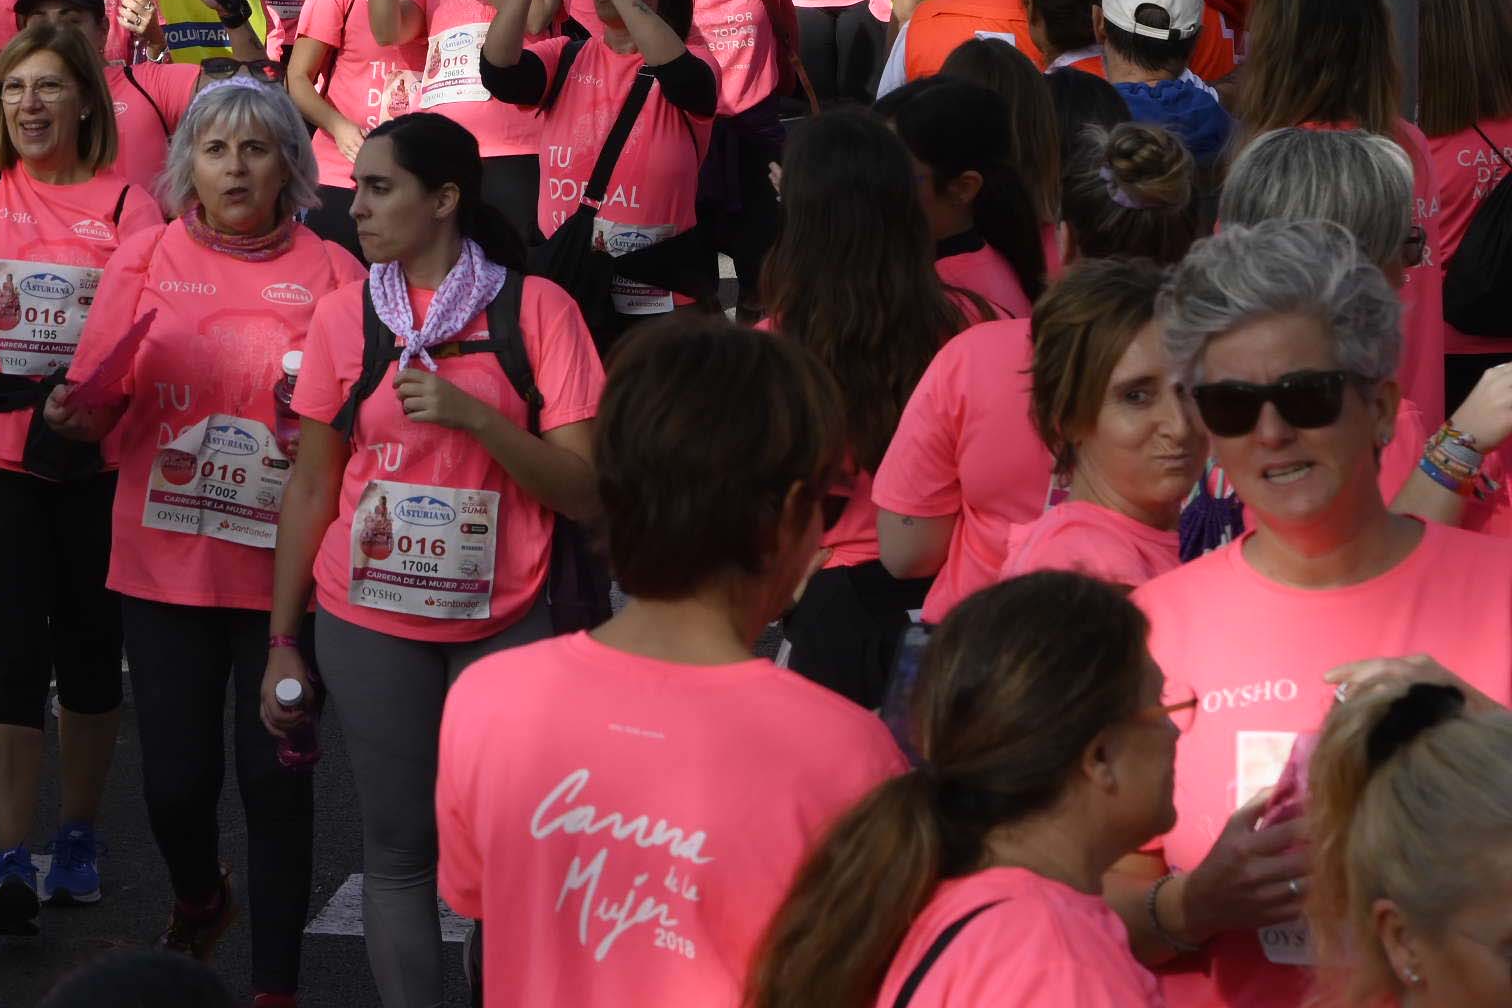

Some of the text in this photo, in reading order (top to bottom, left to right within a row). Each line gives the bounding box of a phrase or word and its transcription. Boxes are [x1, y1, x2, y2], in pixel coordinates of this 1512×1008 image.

[727, 11, 753, 23] POR
[712, 26, 755, 38] TODAS
[443, 54, 469, 68] 016
[547, 145, 572, 168] TU
[24, 280, 70, 295] ASTURIANA
[159, 280, 216, 296] OYSHO
[24, 307, 66, 325] 016
[31, 328, 57, 340] 1195
[155, 382, 193, 412] TU
[367, 443, 404, 472] TU
[199, 460, 247, 485] 016
[199, 482, 238, 500] 17002
[158, 509, 200, 526] OYSHO
[224, 504, 254, 518] MUJER
[396, 505, 452, 523] ASTURIANA
[230, 521, 273, 540] Santander
[398, 535, 446, 558] 016
[401, 559, 439, 574] 17004
[366, 569, 402, 587] CARRERA
[402, 575, 415, 586] DE
[415, 577, 427, 588] LA
[428, 578, 457, 591] MUJER
[361, 586, 402, 603] OYSHO
[436, 597, 480, 610] Santander
[1202, 679, 1298, 714] OYSHO
[554, 847, 680, 963] Mujer
